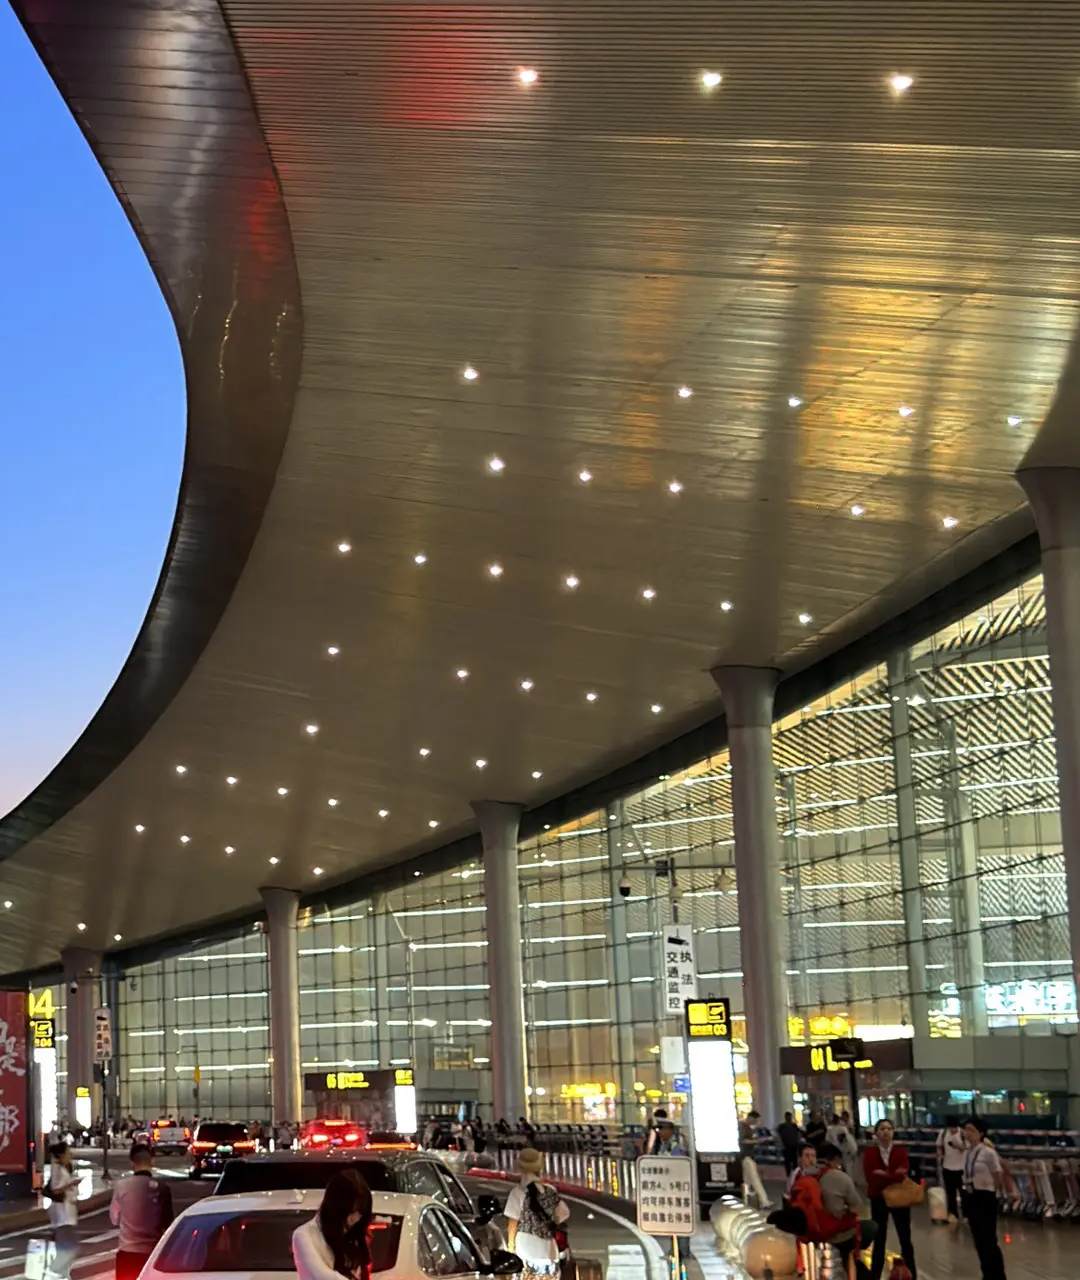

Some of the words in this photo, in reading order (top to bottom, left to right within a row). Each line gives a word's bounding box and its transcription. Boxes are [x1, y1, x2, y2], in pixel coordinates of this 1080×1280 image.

[667, 952, 680, 1009] 交通监控
[680, 951, 694, 1000] 执法
